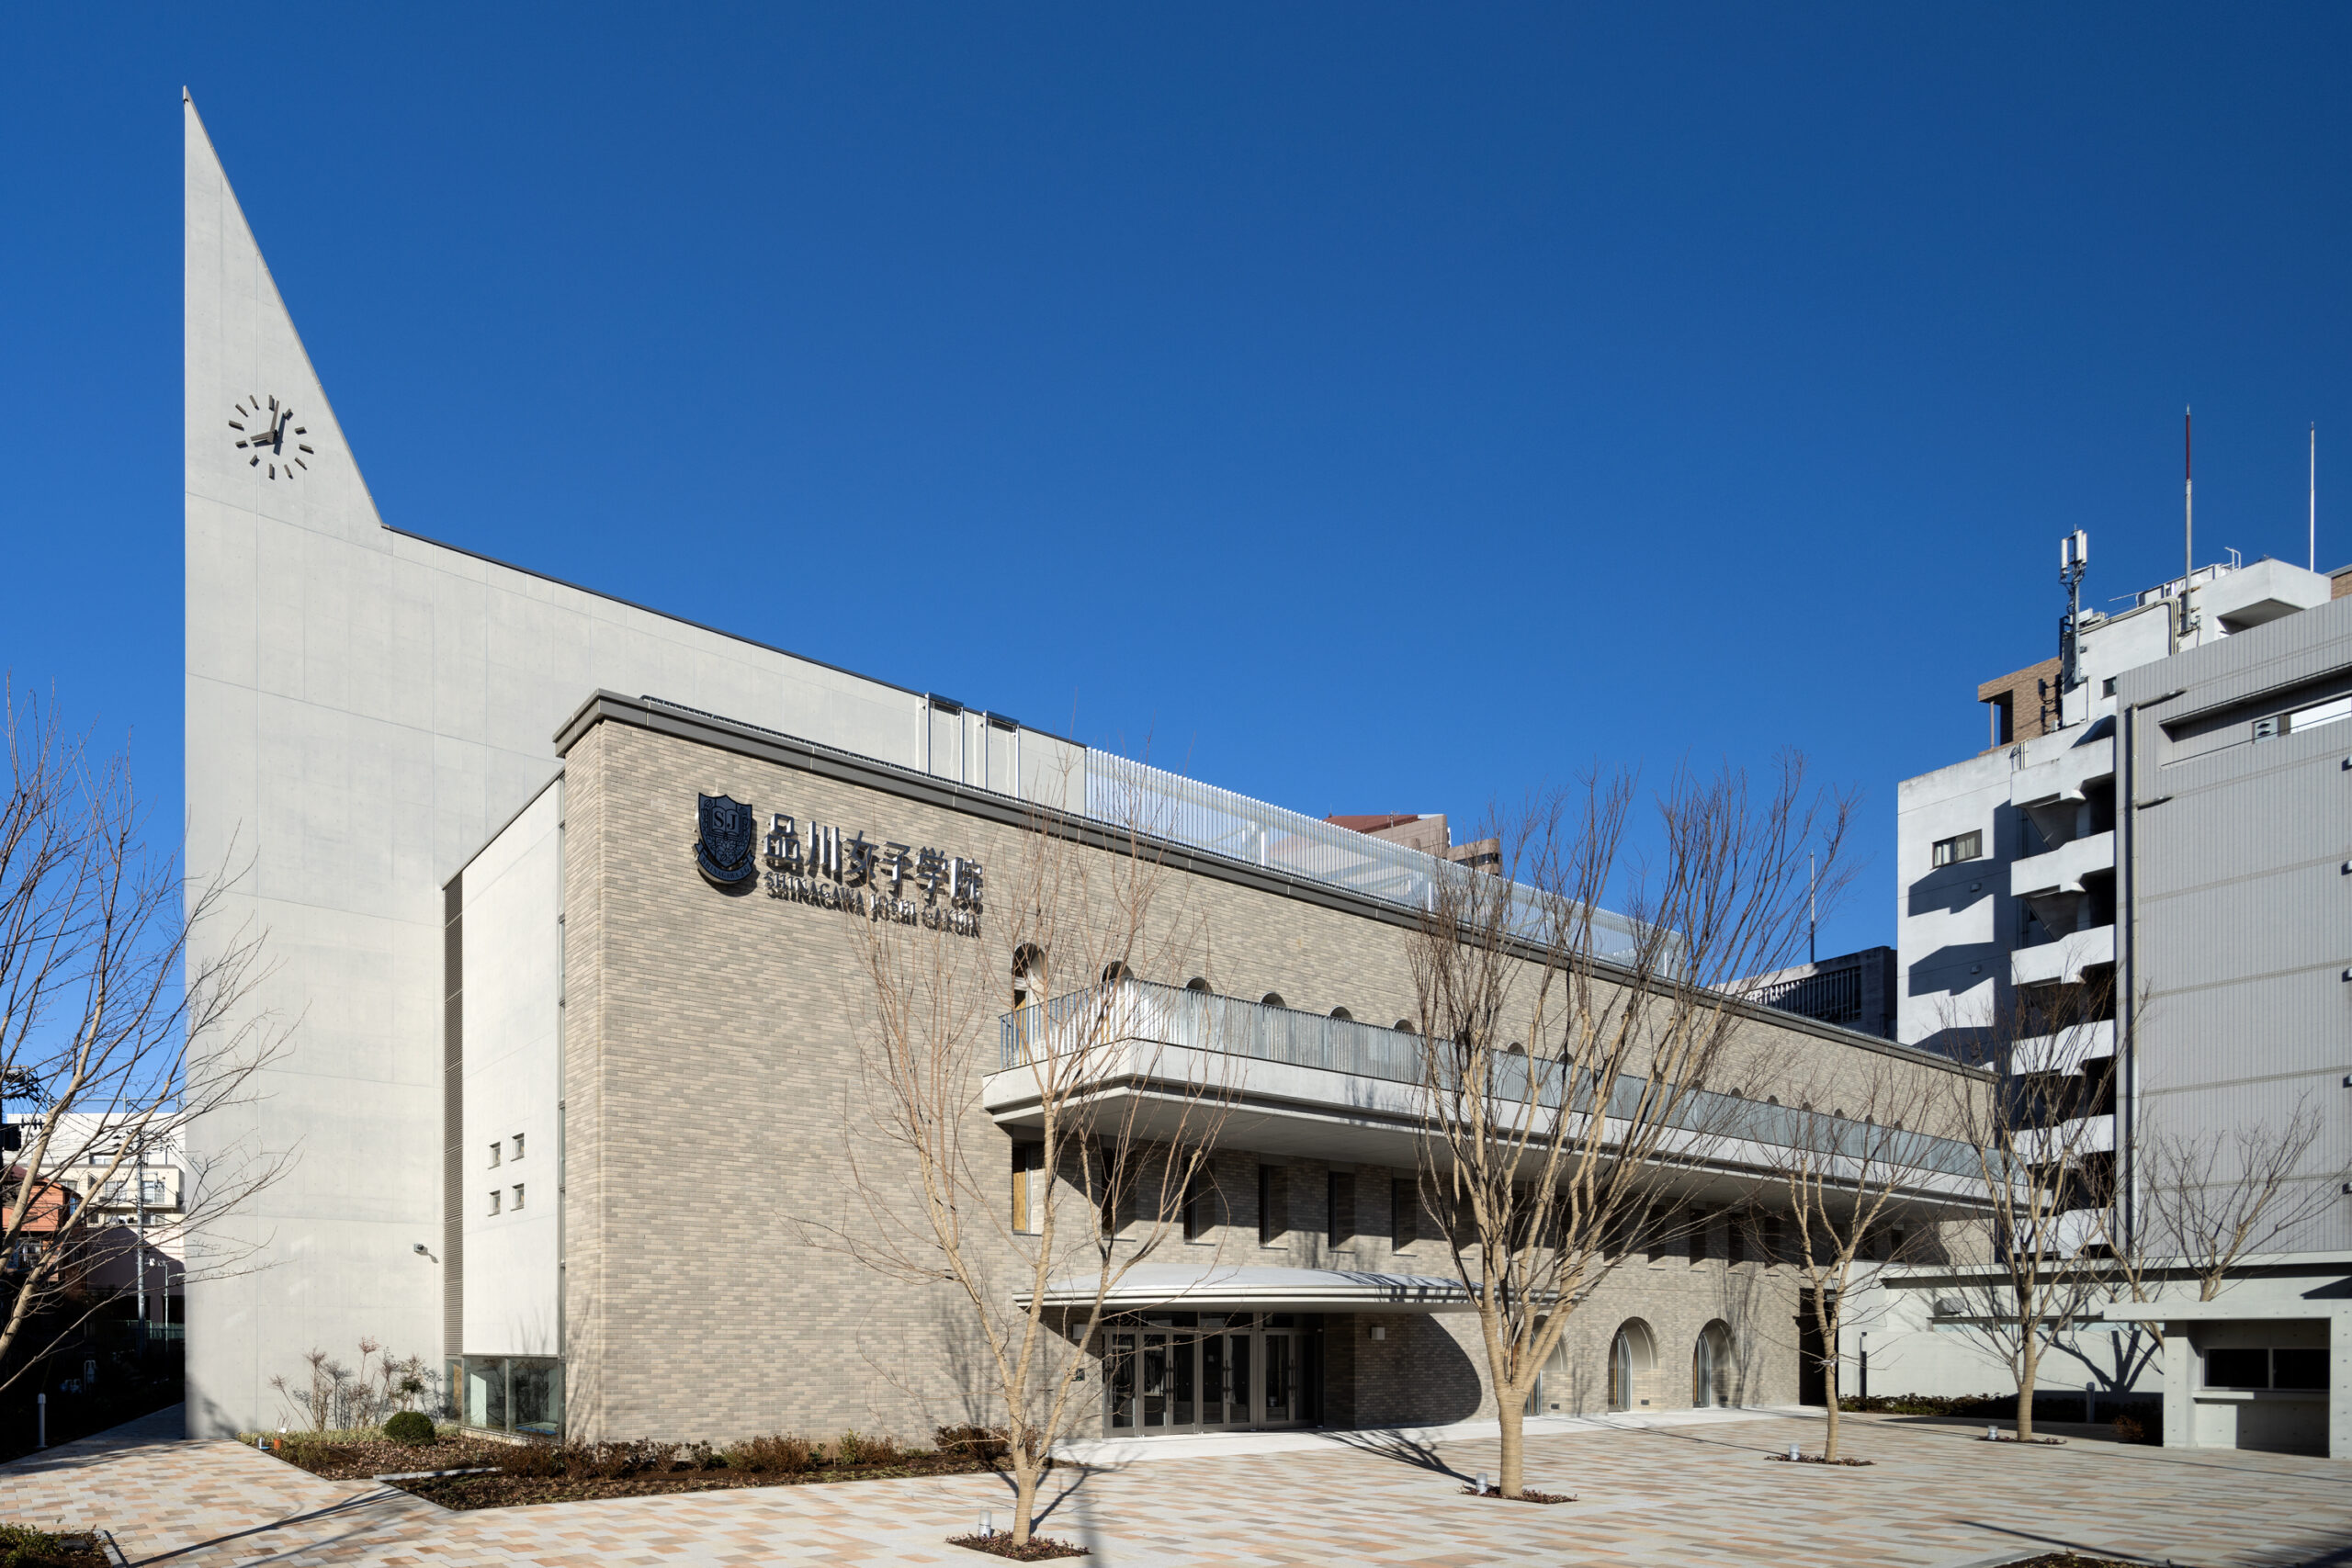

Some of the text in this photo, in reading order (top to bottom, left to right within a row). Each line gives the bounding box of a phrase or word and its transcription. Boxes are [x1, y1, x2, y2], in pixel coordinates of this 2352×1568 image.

[713, 810, 738, 830] SJ
[763, 812, 983, 902] 品川女子学院
[763, 871, 865, 908] SHINAGAWA
[869, 894, 917, 916] JOSHI
